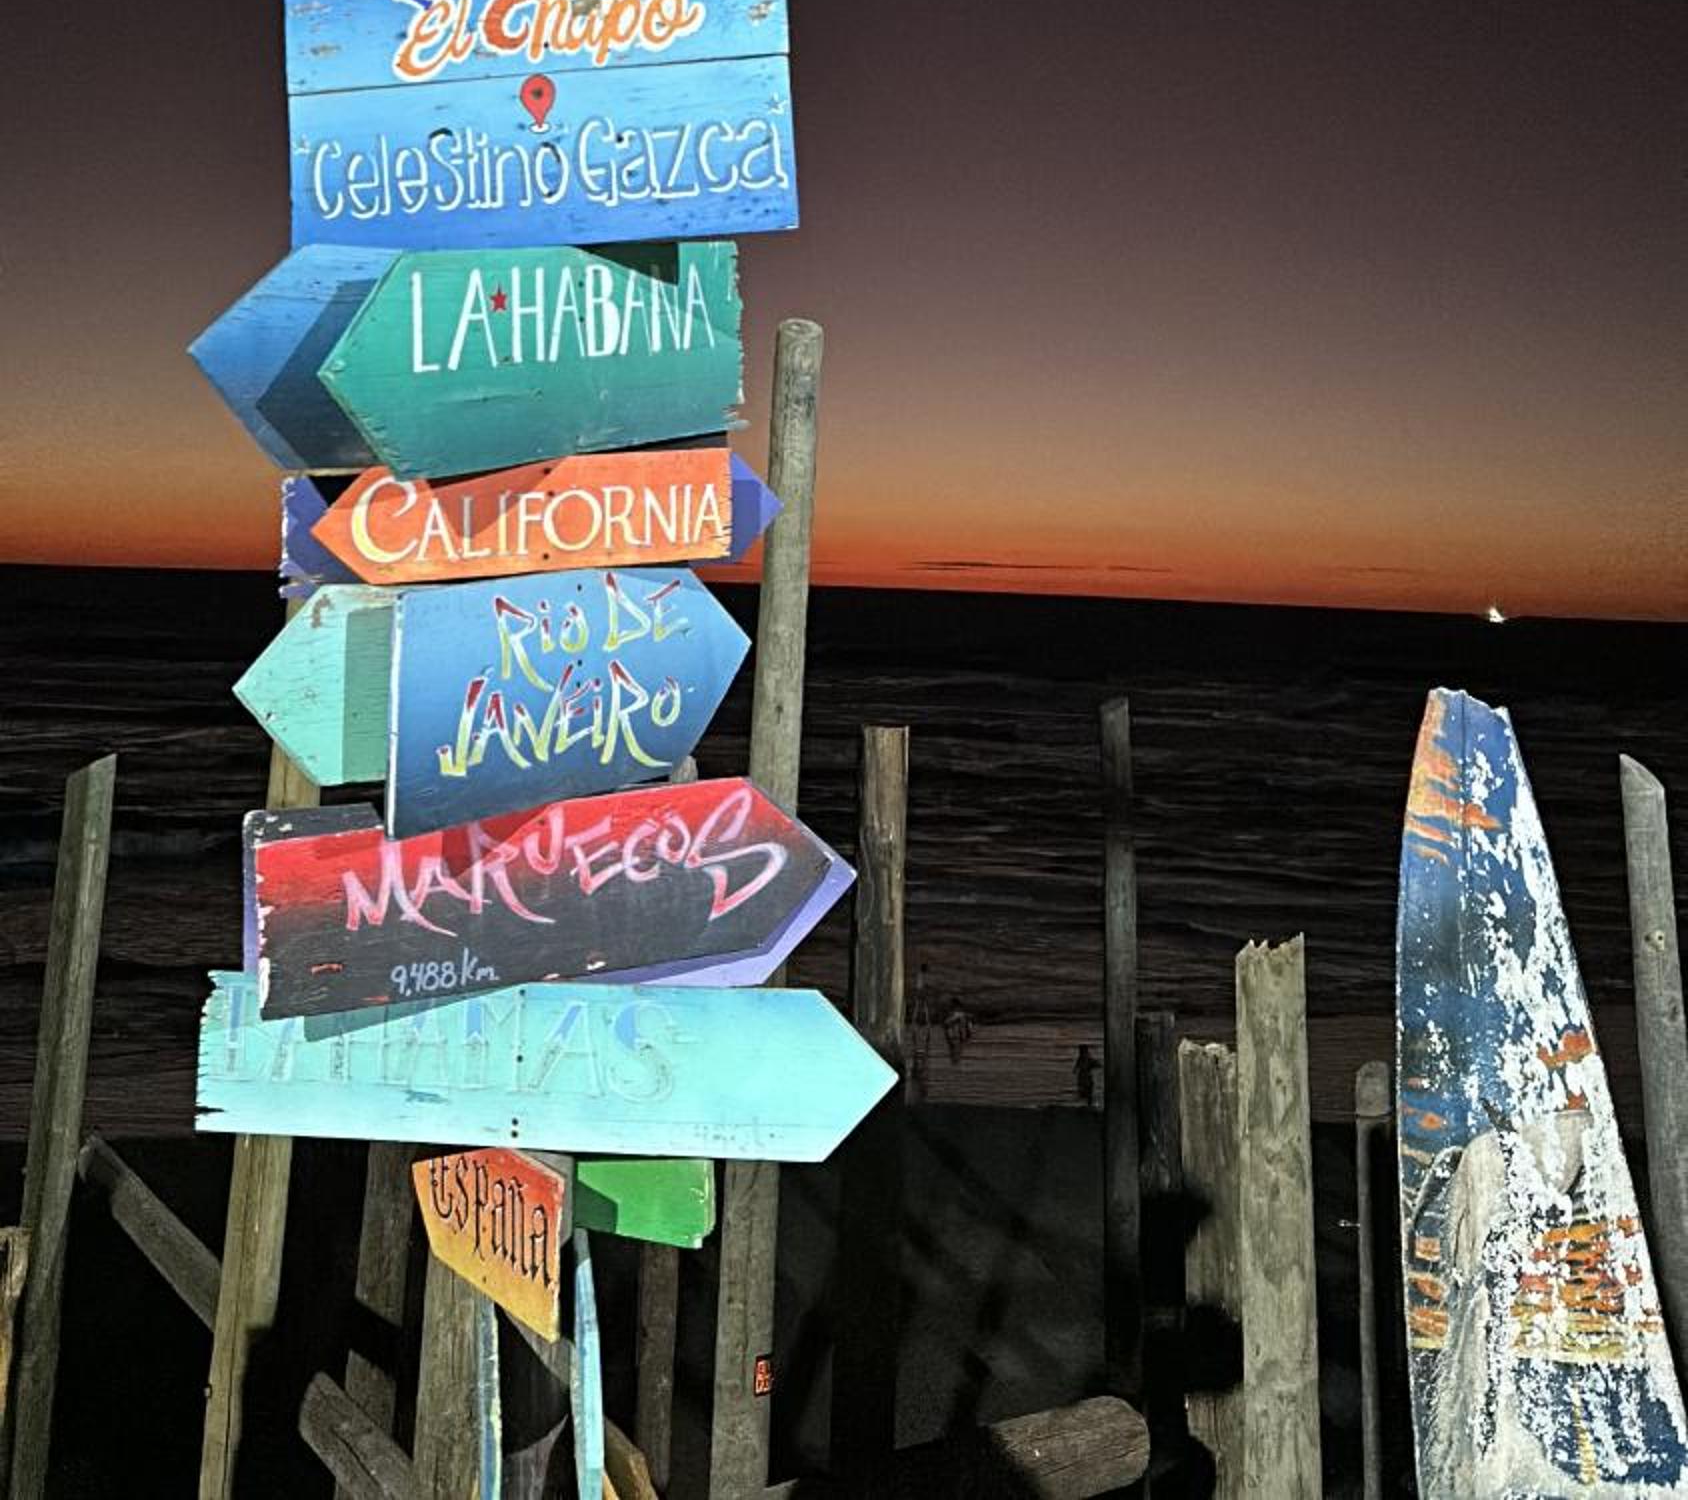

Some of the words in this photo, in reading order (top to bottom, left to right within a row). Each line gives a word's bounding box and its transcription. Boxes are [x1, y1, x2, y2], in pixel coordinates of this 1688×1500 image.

[411, 267, 499, 372] LA
[511, 263, 715, 363] HABANA
[350, 475, 725, 564] CALIFORNIA
[603, 572, 689, 651] DE
